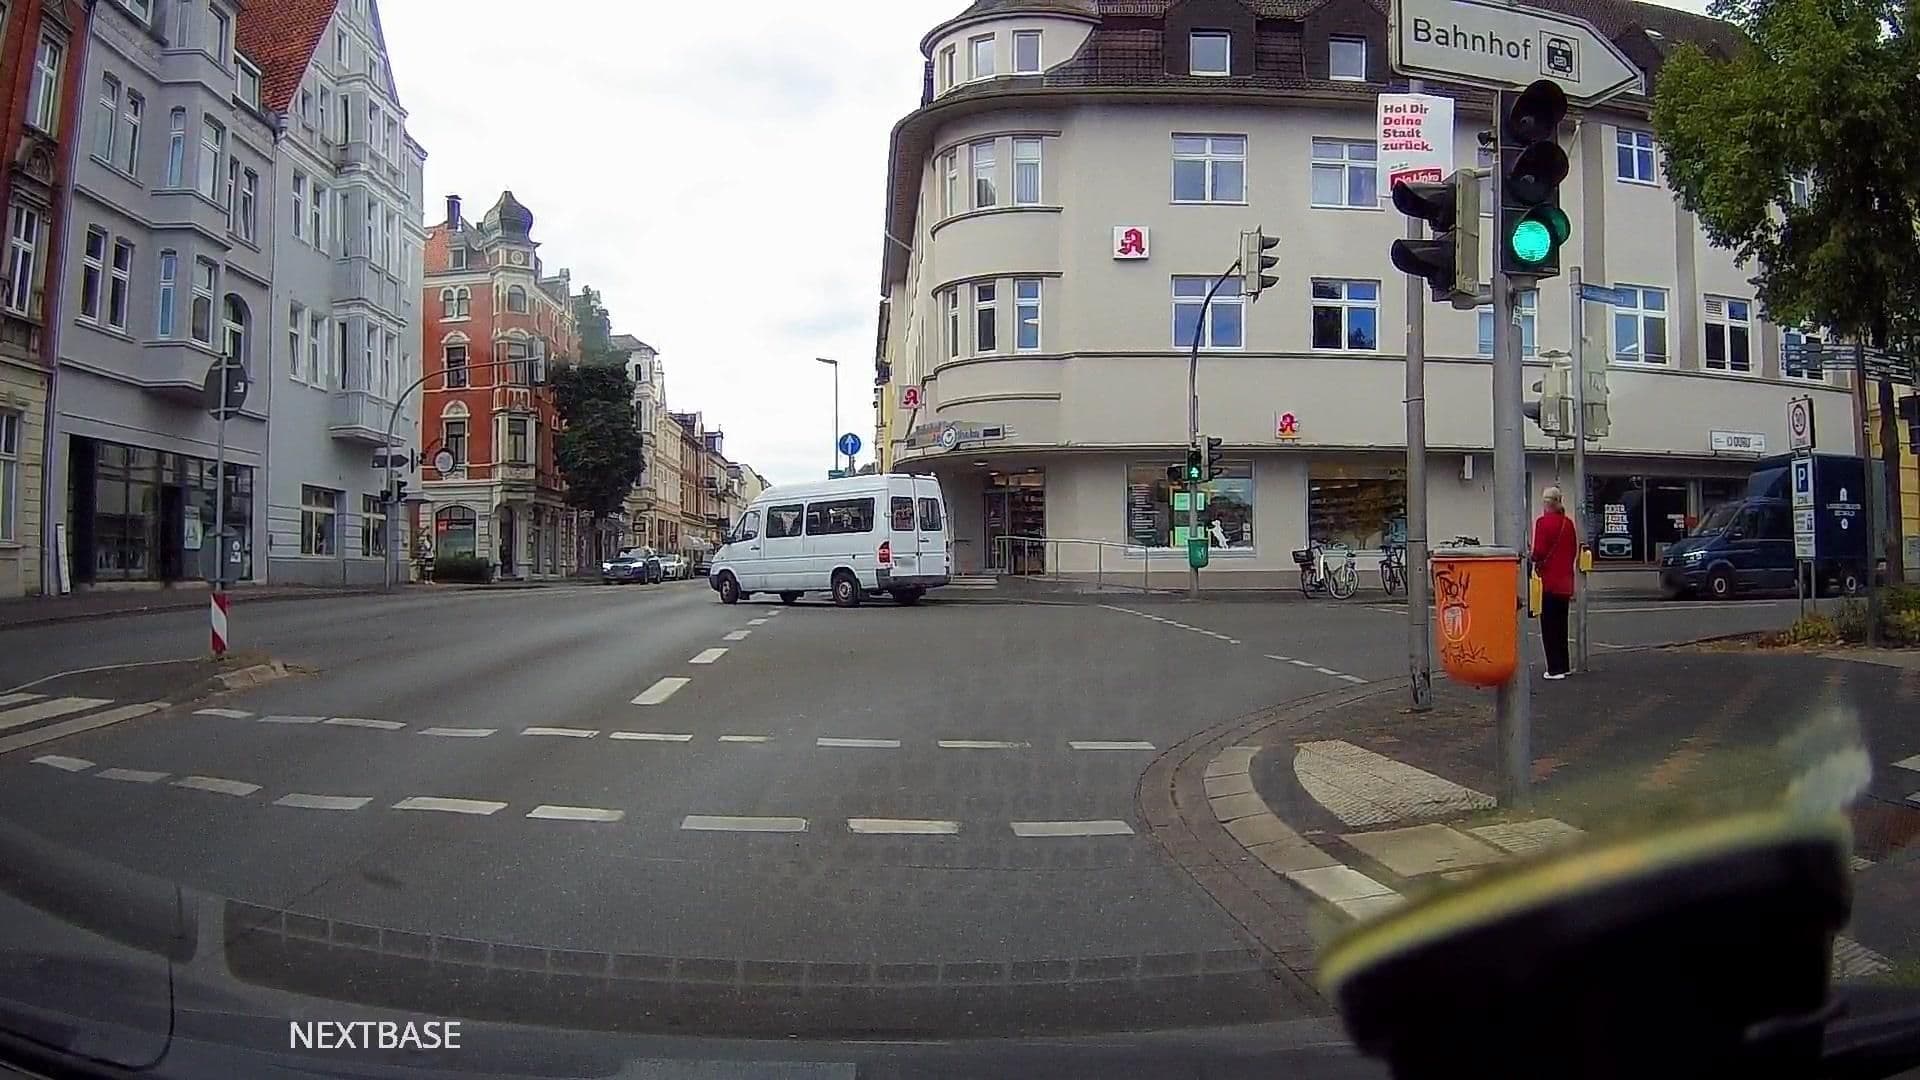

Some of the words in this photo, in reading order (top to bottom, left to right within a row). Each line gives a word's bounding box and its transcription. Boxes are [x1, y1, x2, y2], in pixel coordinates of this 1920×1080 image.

[1413, 18, 1532, 61] Bahnhof
[1384, 104, 1407, 114] Hol
[1410, 104, 1430, 114] Dir
[1383, 116, 1422, 126] Deine
[1383, 128, 1422, 138] Stadt
[1382, 141, 1433, 151] zurück.
[1798, 467, 1806, 489] P
